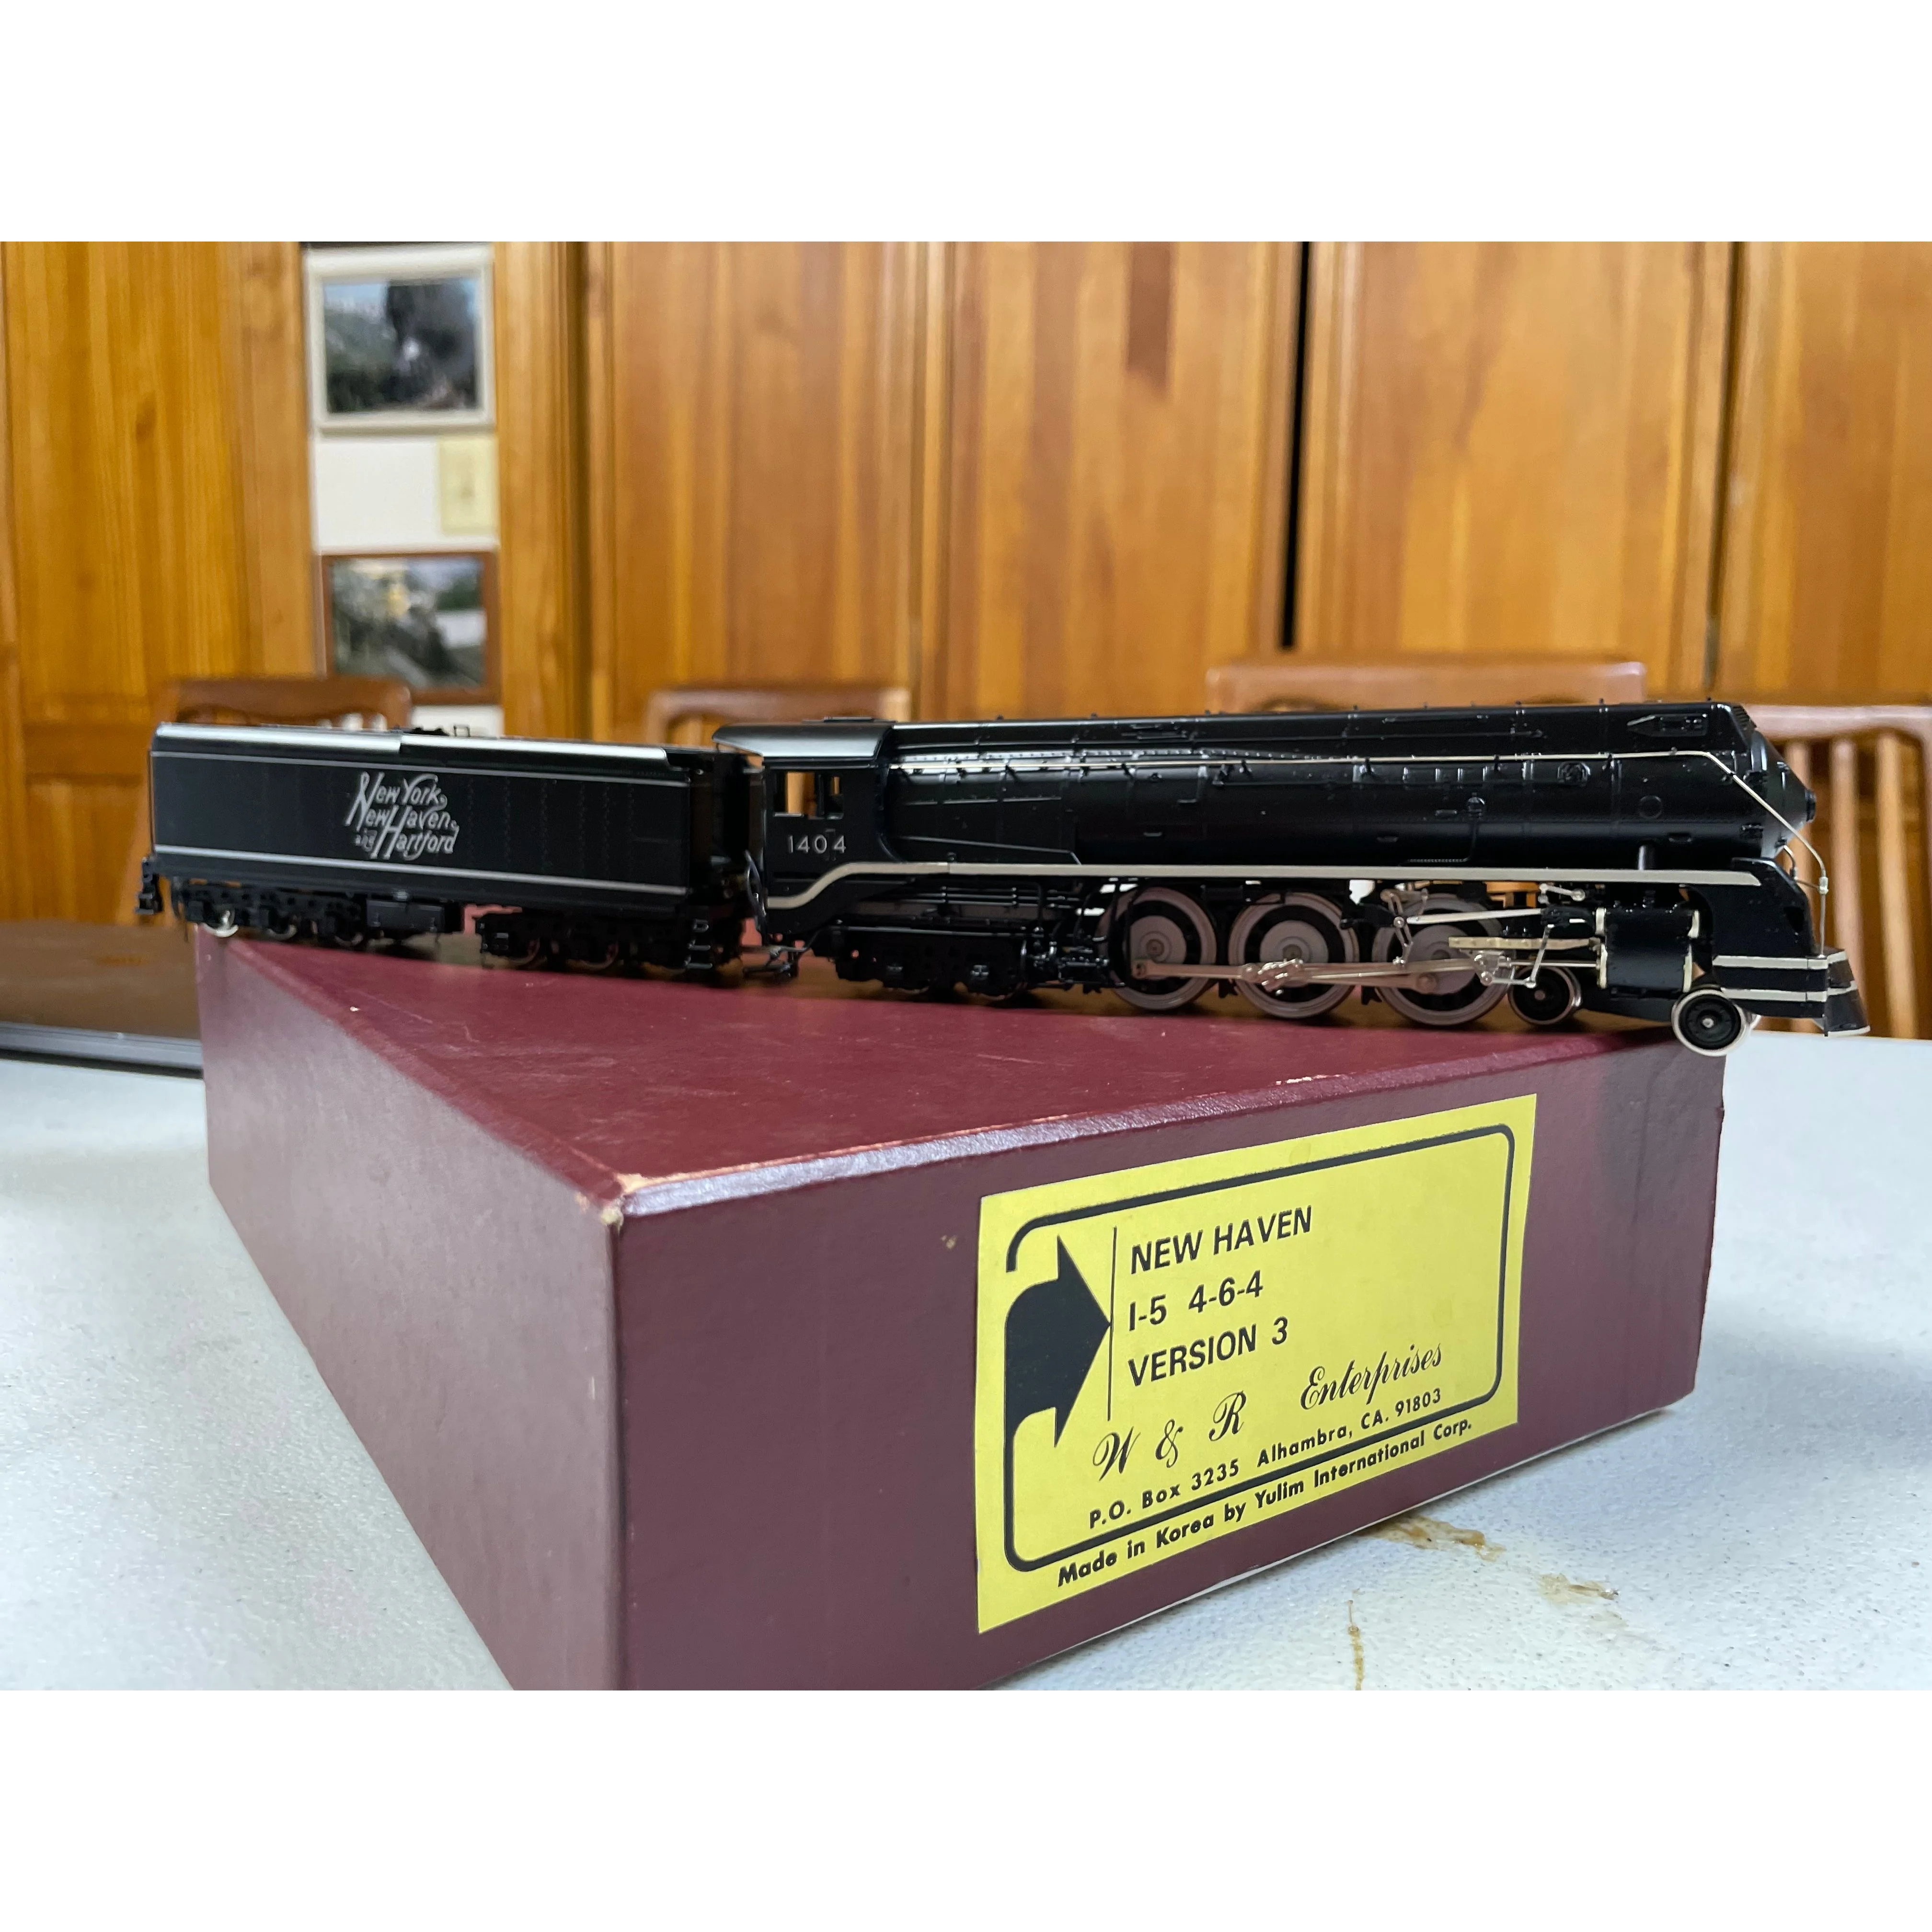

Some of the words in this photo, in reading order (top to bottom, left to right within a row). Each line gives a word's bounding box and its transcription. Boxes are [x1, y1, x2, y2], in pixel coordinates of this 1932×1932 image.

[345, 771, 400, 827] New
[369, 815, 459, 861] Hartford
[787, 834, 846, 854] 1404
[1130, 1230, 1204, 1275] NEW
[1212, 1205, 1312, 1256] HAVEN
[1128, 1294, 1167, 1332] I-5
[1188, 1270, 1264, 1313] 4-6-4
[1127, 1323, 1256, 1387] VERSION
[1271, 1316, 1288, 1346] 3
[1092, 1426, 1141, 1482] W
[1155, 1419, 1184, 1469] &
[1208, 1390, 1248, 1441] R
[1300, 1343, 1443, 1410] Enterprises
[1089, 1500, 1132, 1530] P.O.
[1142, 1483, 1181, 1509] Box
[1191, 1458, 1240, 1491] 3235
[1256, 1425, 1353, 1468] Alhambra,
[1360, 1408, 1391, 1430] CA.
[1394, 1388, 1442, 1417] 91803
[1057, 1550, 1118, 1588] Made
[1127, 1539, 1146, 1560] in
[1155, 1514, 1215, 1549] Korea
[1224, 1502, 1247, 1523] by
[1254, 1480, 1305, 1509] Yulim
[1314, 1429, 1426, 1488] International
[1433, 1419, 1473, 1441] Corp.
